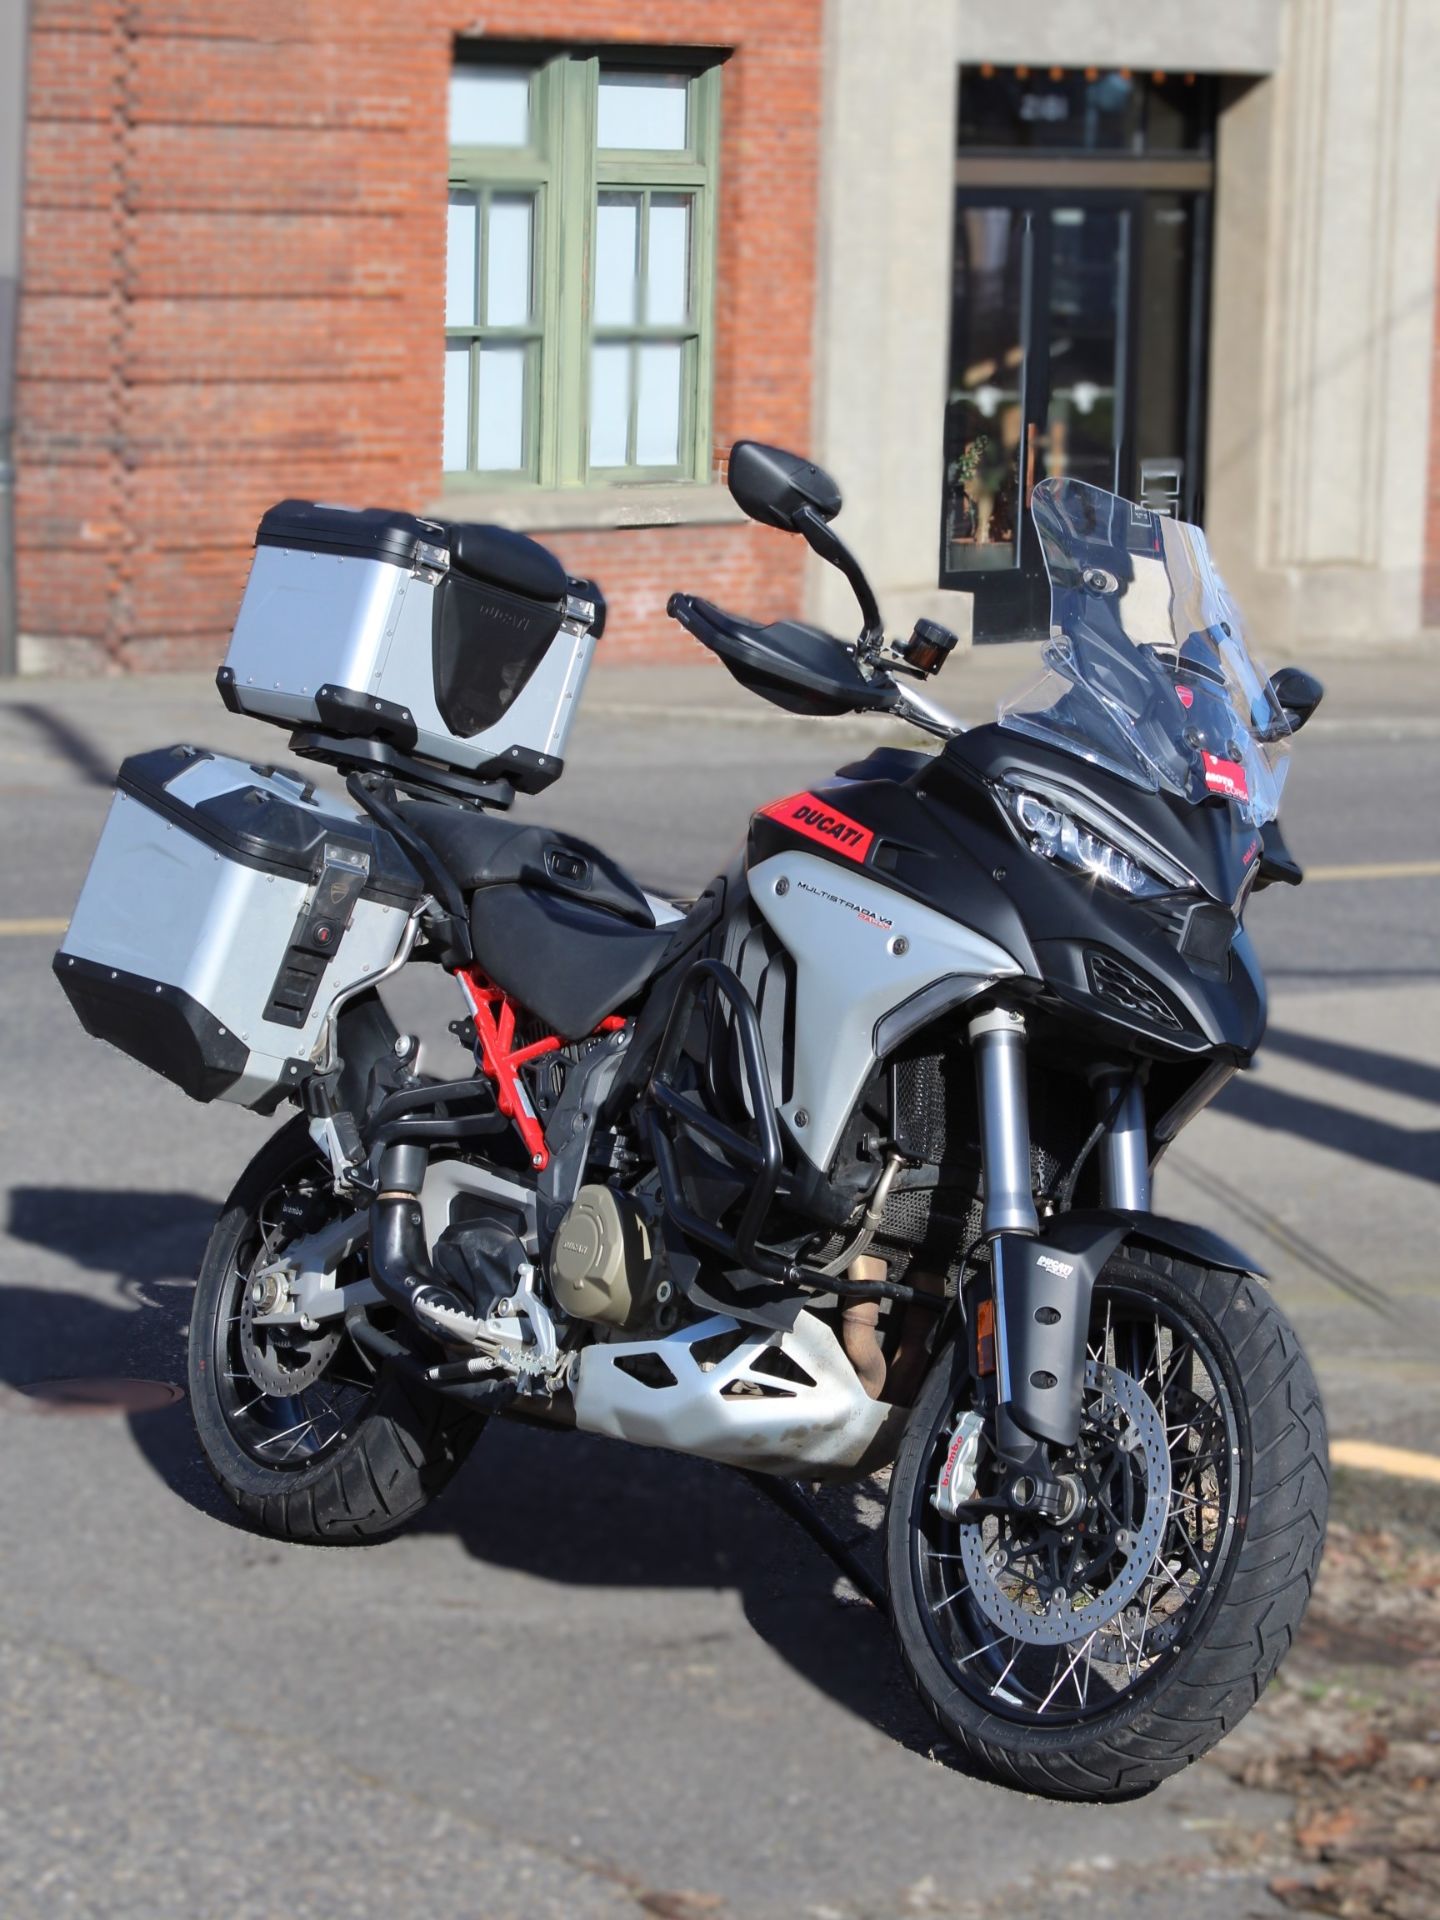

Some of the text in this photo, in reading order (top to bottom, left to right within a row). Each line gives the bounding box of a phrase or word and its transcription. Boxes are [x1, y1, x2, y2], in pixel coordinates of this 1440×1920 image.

[1205, 771, 1234, 787] MOTO
[792, 806, 864, 847] DUCATI
[797, 881, 893, 926] MULTISTRADA V4
[941, 1435, 964, 1488] brembo
